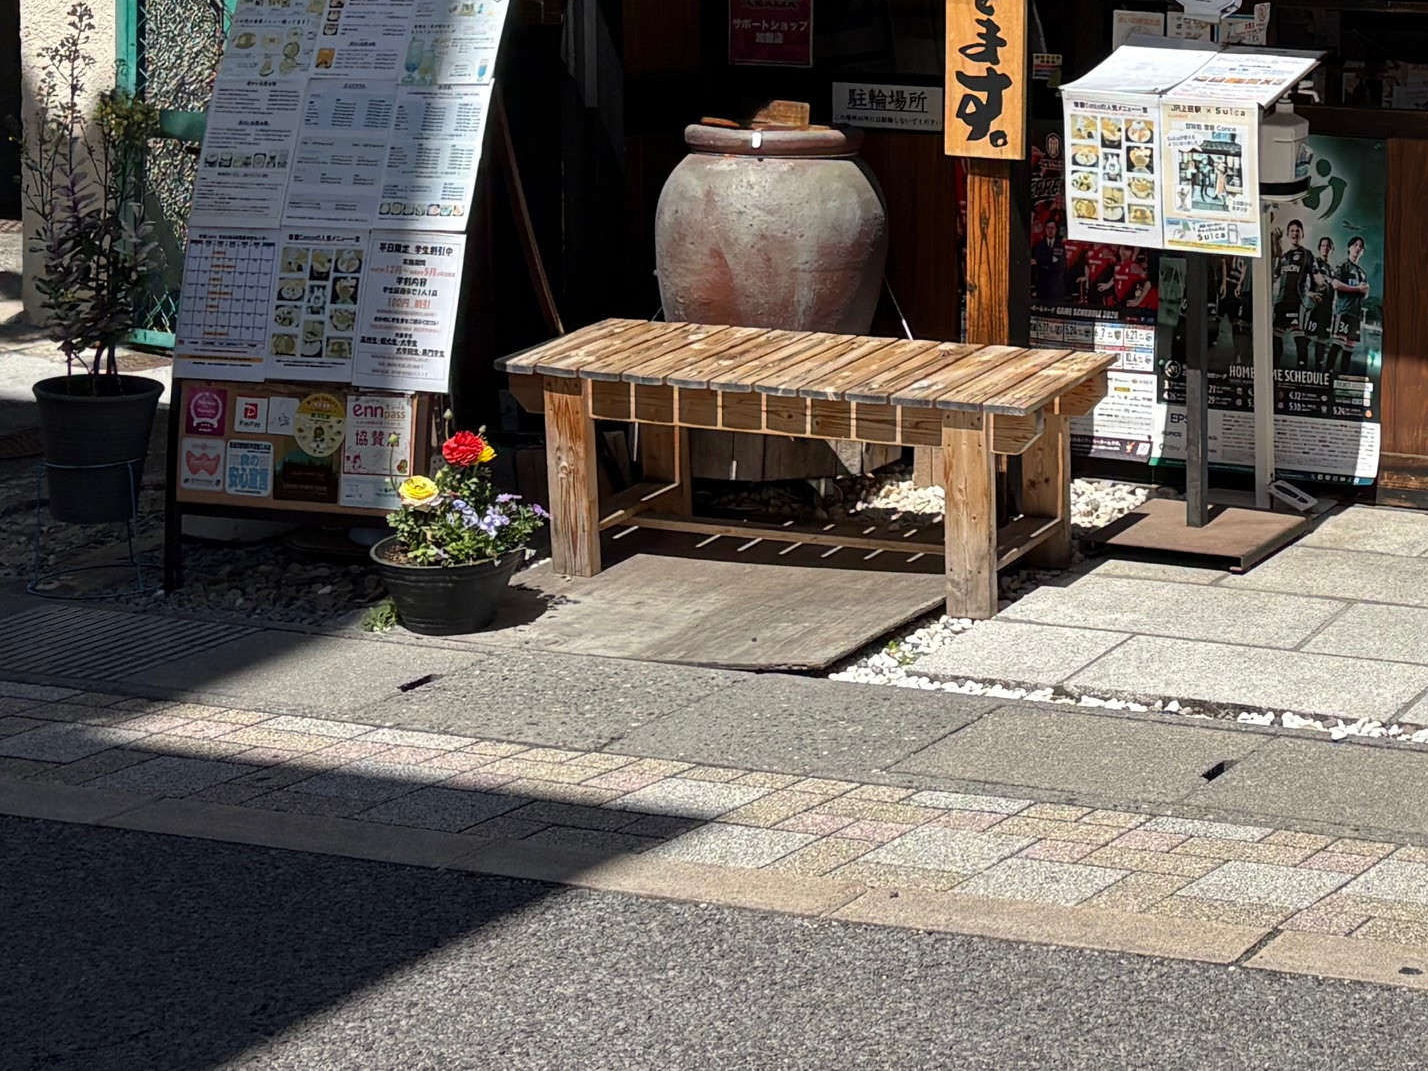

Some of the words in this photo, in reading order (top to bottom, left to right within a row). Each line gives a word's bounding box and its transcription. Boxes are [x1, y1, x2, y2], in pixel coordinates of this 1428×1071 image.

[847, 88, 929, 112] 駐輪場所
[1284, 369, 1330, 386] SCHEDULE
[353, 403, 384, 419] enn
